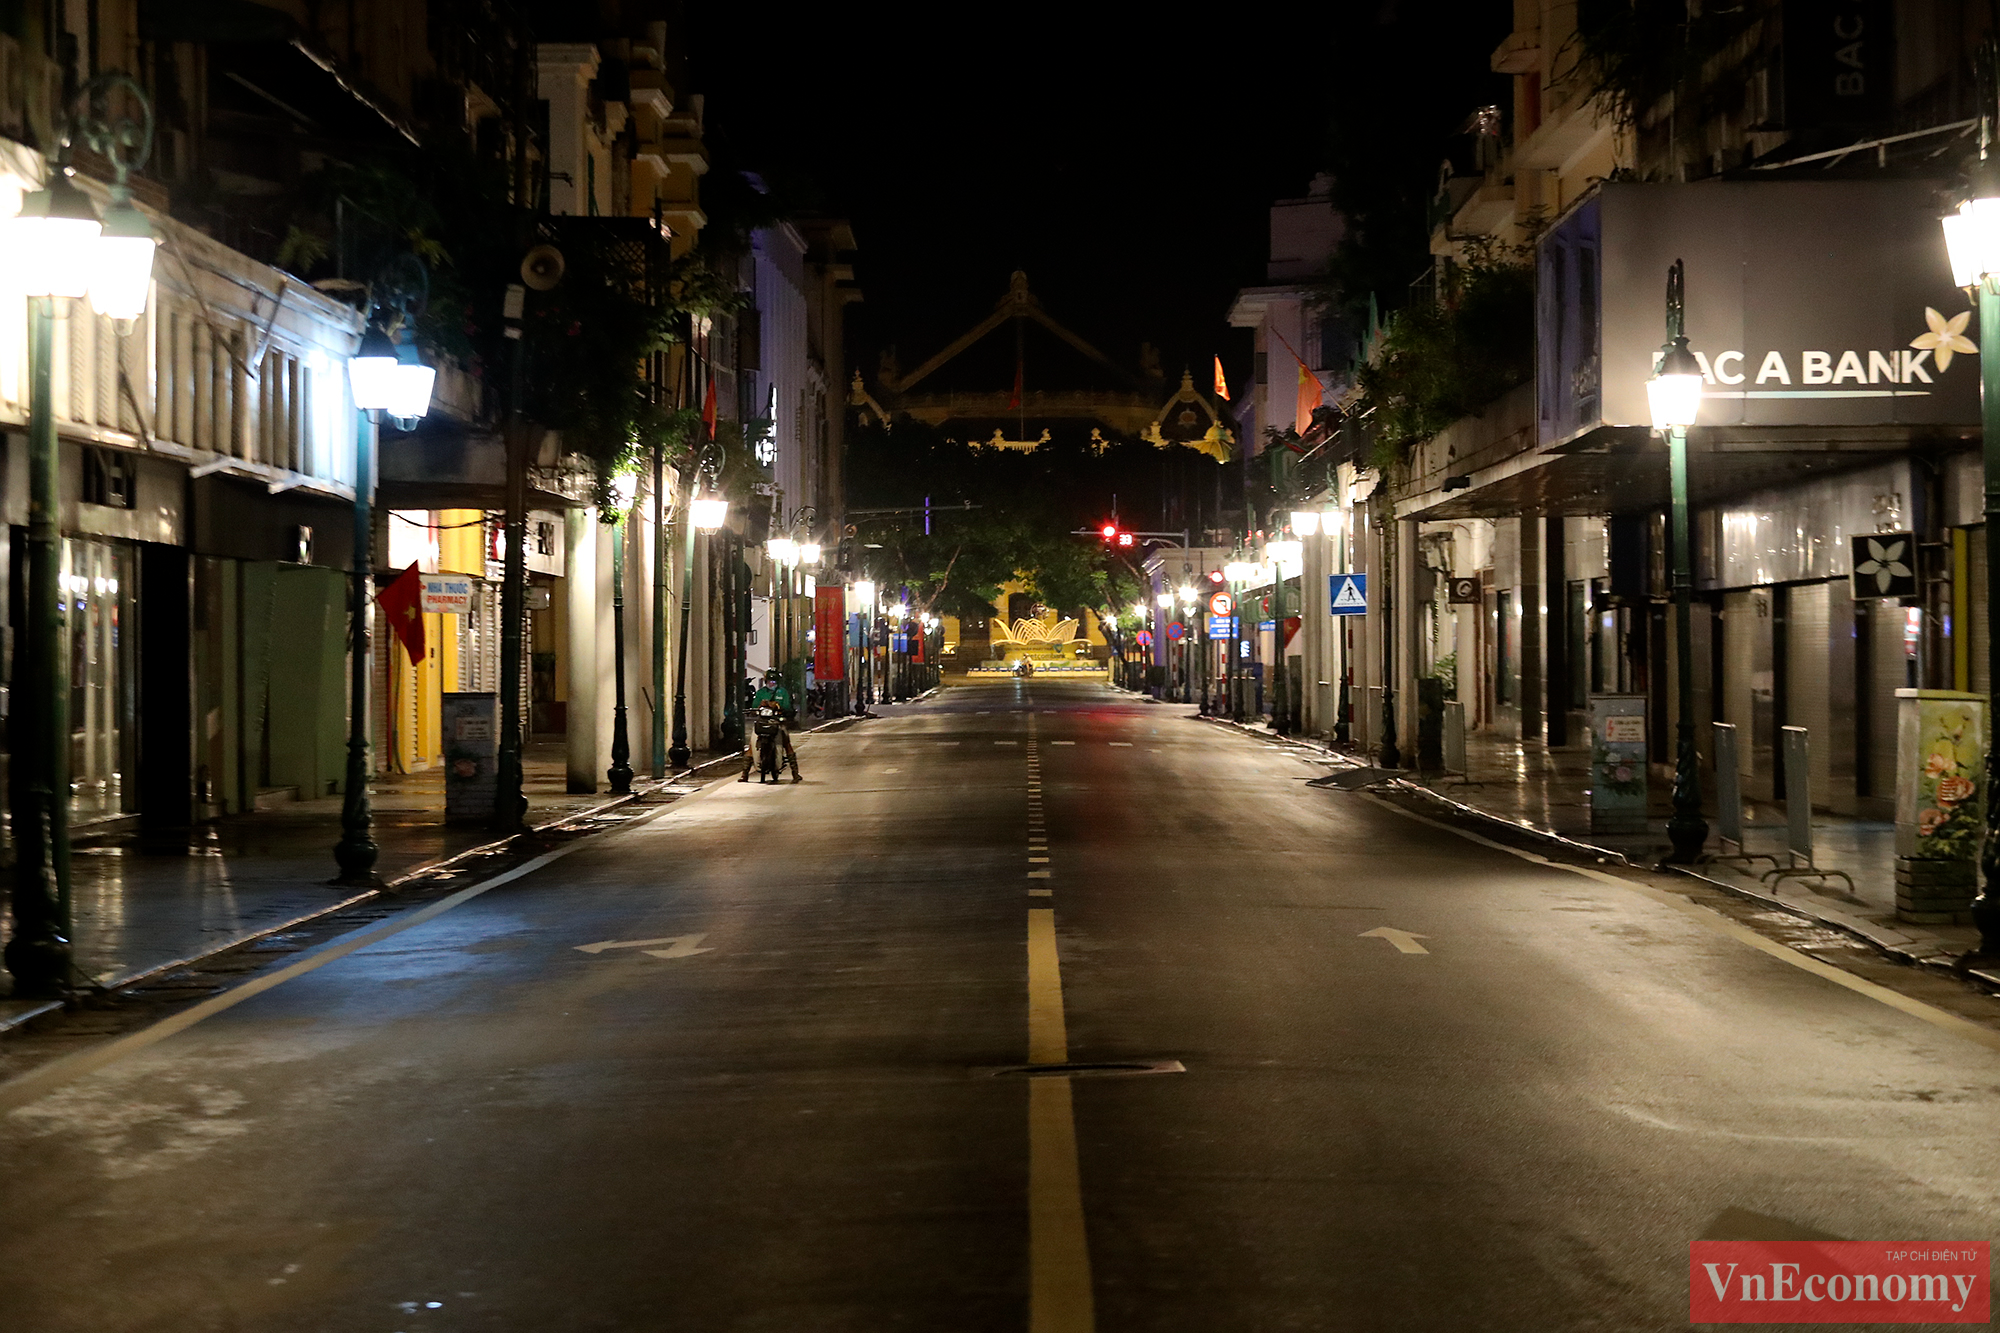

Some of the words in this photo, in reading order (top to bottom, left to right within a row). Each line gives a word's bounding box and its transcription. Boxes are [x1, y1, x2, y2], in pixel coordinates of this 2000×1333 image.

[1833, 13, 1865, 96] BAC
[1755, 350, 1792, 385] A
[1802, 350, 1934, 385] BANK
[427, 595, 468, 604] PHARMACY
